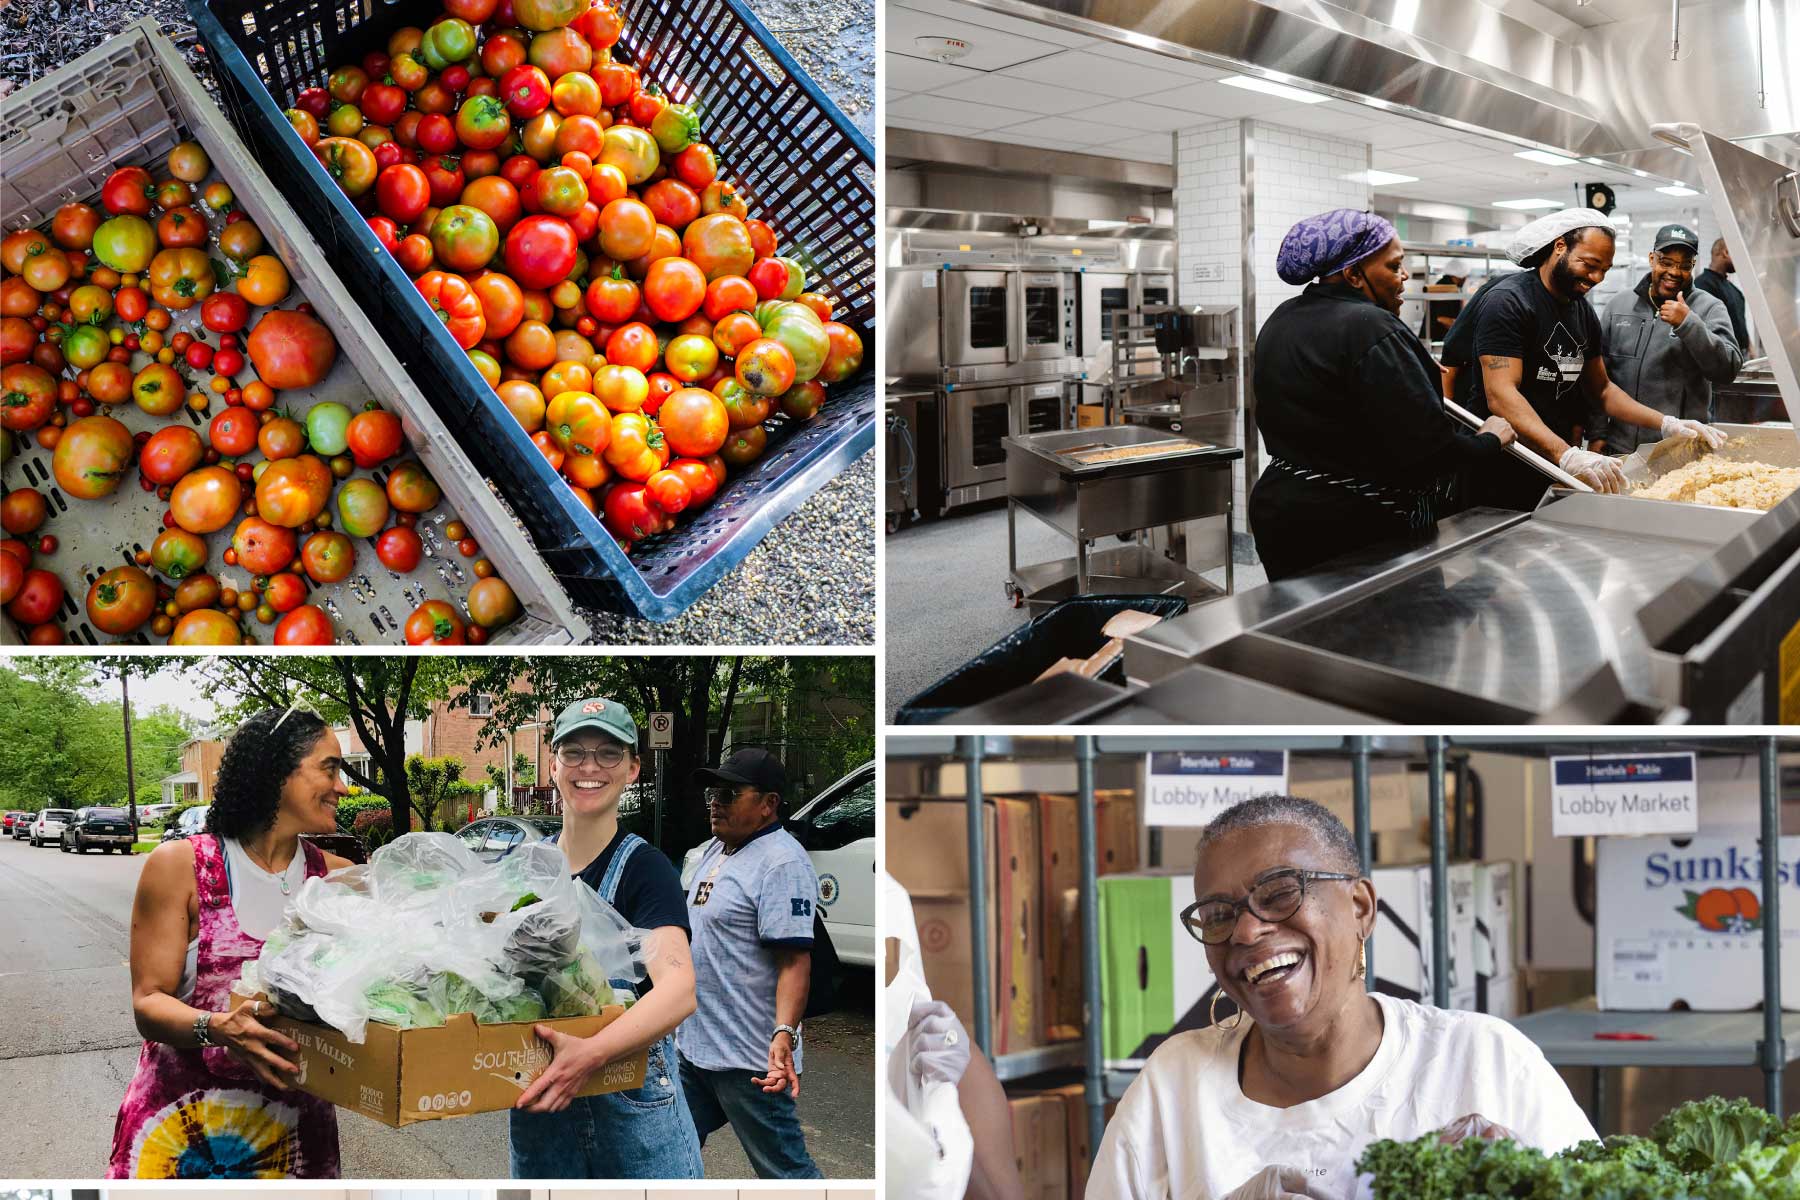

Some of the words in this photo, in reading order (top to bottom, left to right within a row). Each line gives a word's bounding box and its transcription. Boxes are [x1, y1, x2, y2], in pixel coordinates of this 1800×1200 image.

[1152, 785, 1209, 808] Lobby
[1559, 795, 1617, 817] Lobby
[1622, 793, 1691, 813] Market
[603, 1060, 637, 1075] WOMEN
[603, 1071, 635, 1086] OWNED
